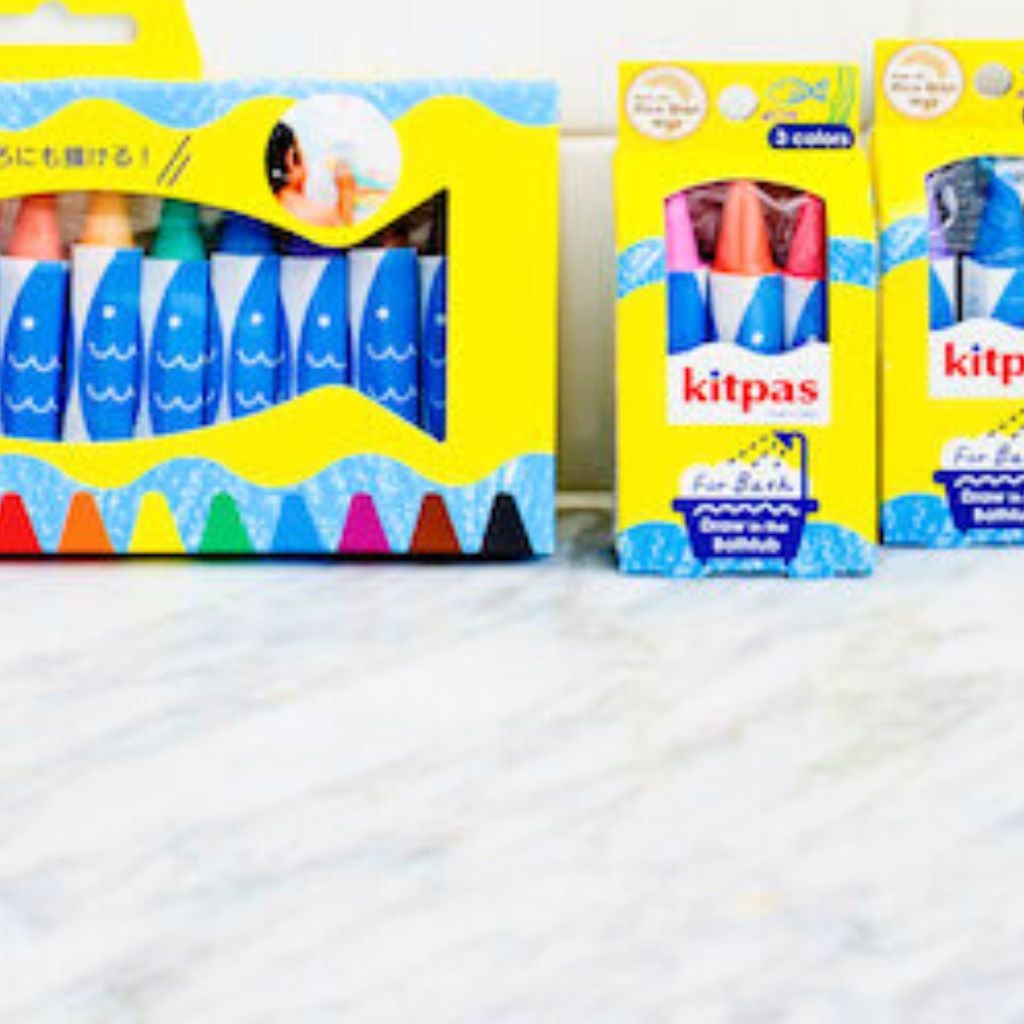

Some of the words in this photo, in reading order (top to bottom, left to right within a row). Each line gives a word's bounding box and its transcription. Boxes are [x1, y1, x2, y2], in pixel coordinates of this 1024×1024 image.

[792, 127, 852, 147] colors
[944, 341, 1024, 386] kitp
[682, 365, 819, 414] kitpas
[693, 472, 726, 493] For
[733, 469, 795, 494] Bath
